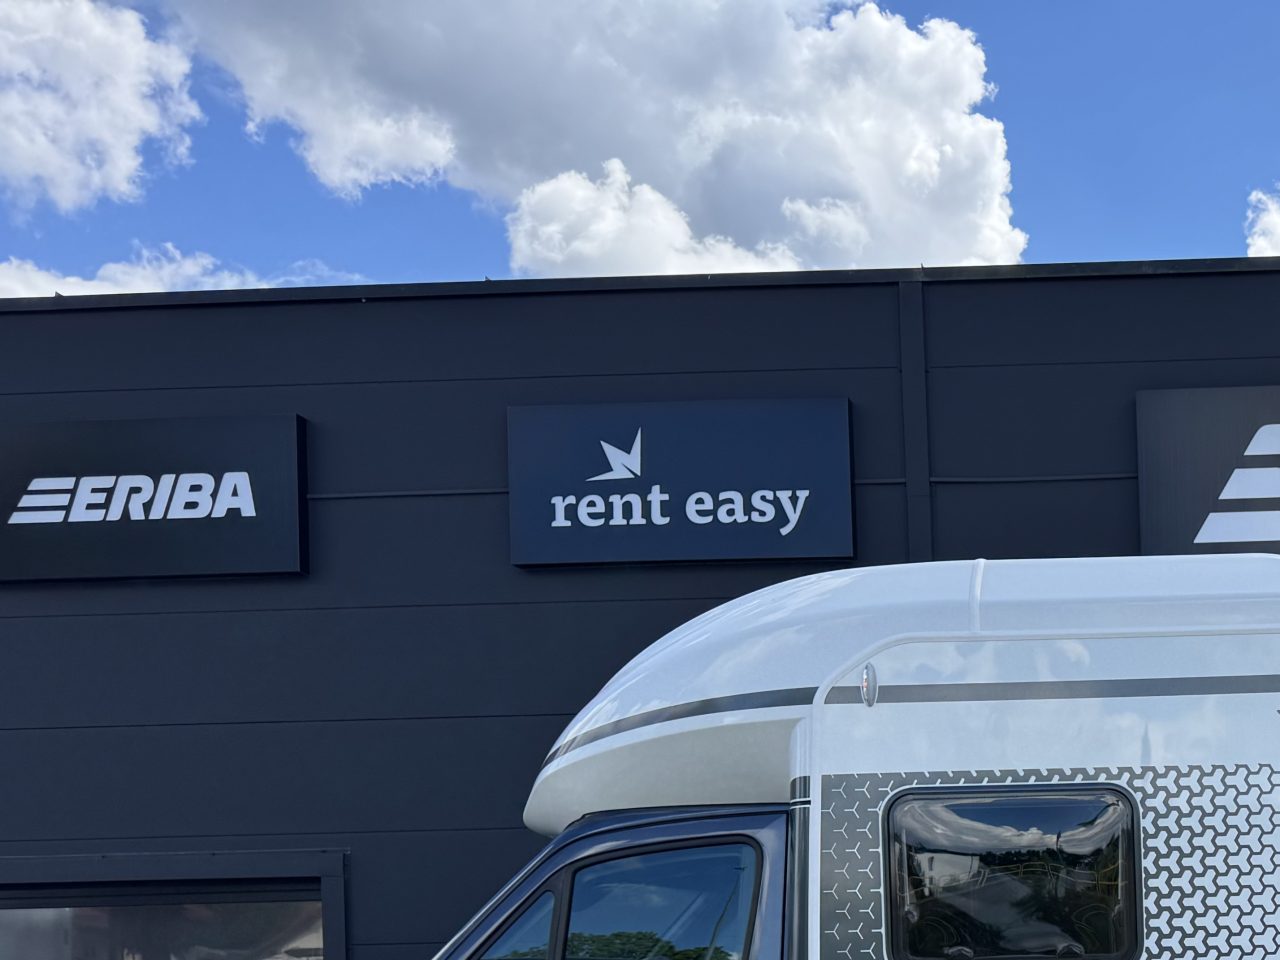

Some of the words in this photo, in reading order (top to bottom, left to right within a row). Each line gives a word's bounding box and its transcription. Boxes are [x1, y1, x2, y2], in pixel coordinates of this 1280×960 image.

[68, 471, 257, 524] ERIBA
[551, 485, 671, 527] rent
[686, 490, 810, 536] easy
